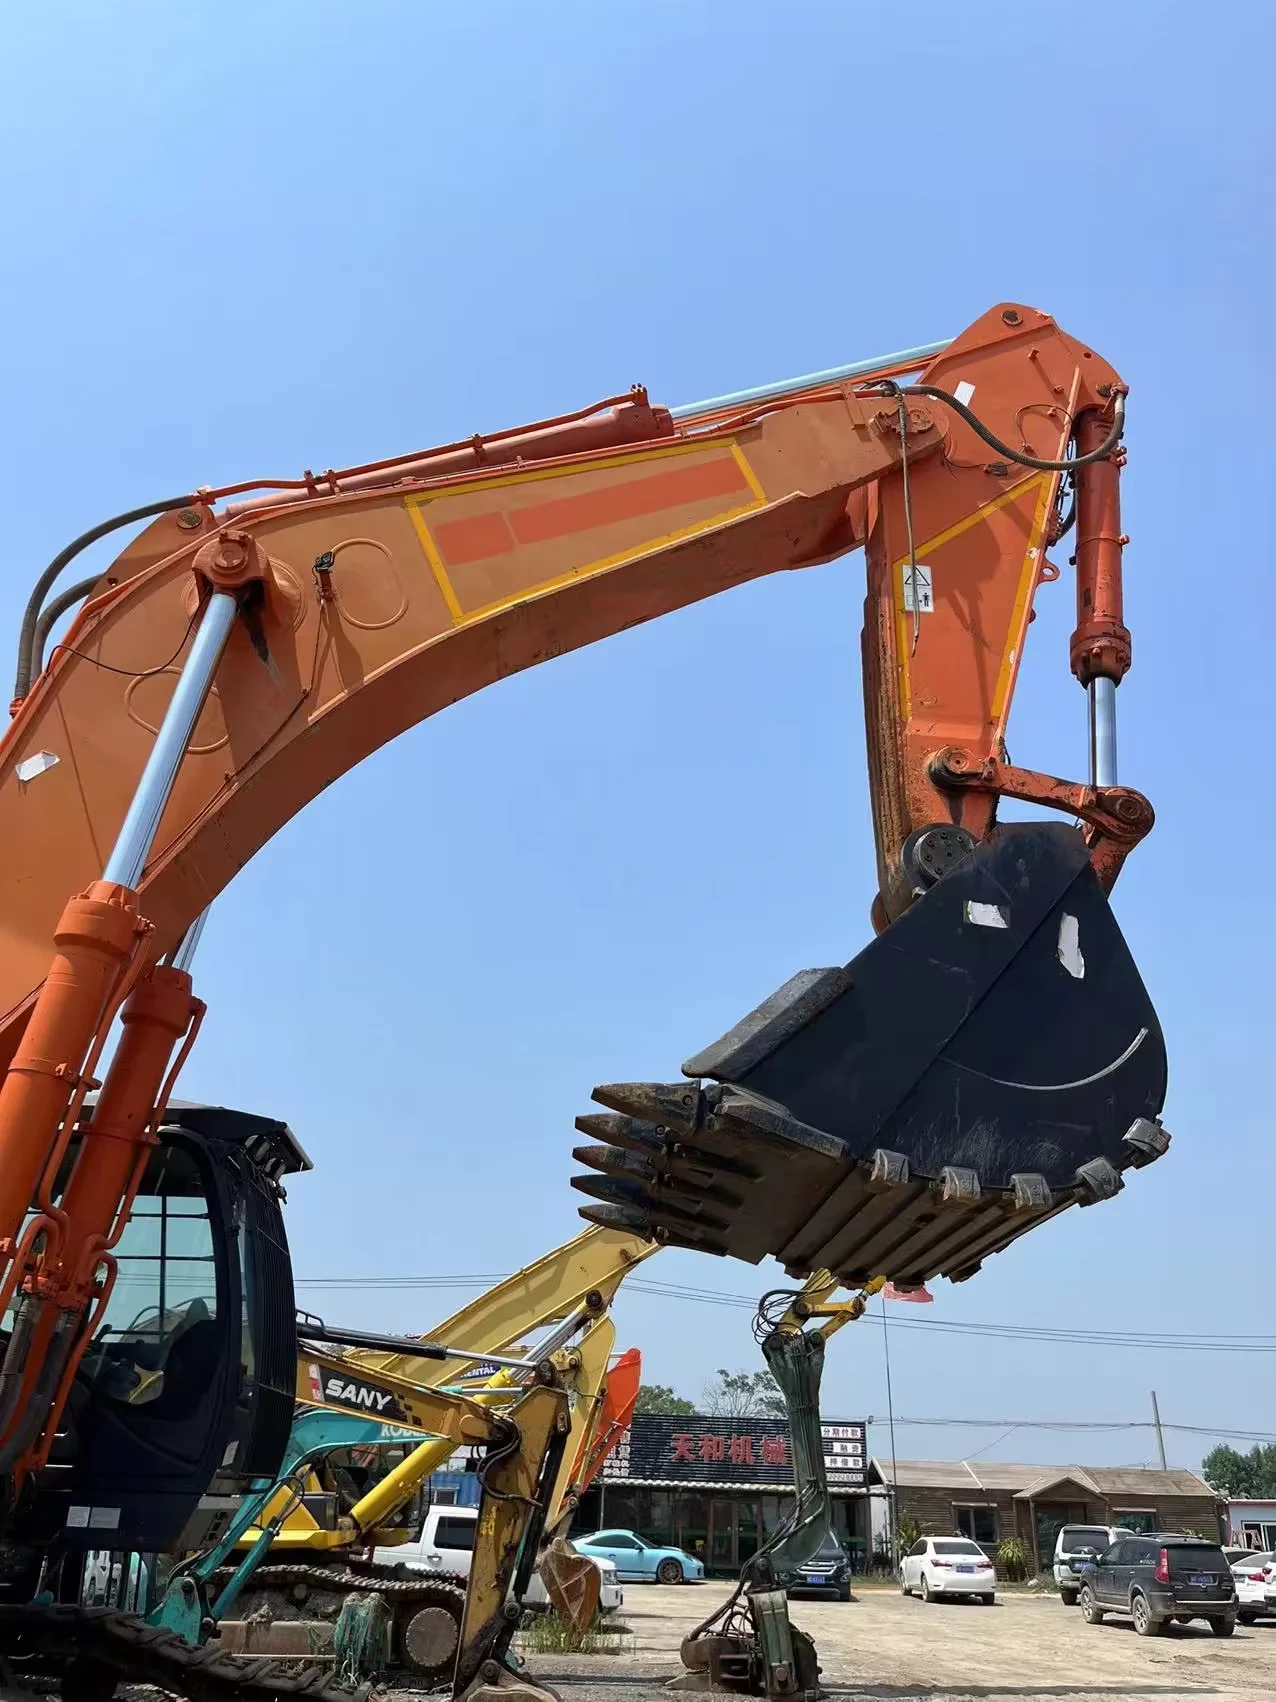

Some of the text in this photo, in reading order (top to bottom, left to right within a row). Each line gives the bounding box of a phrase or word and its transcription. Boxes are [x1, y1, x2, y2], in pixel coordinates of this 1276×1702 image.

[325, 1378, 393, 1411] SANY
[669, 1433, 787, 1465] 天和机械
